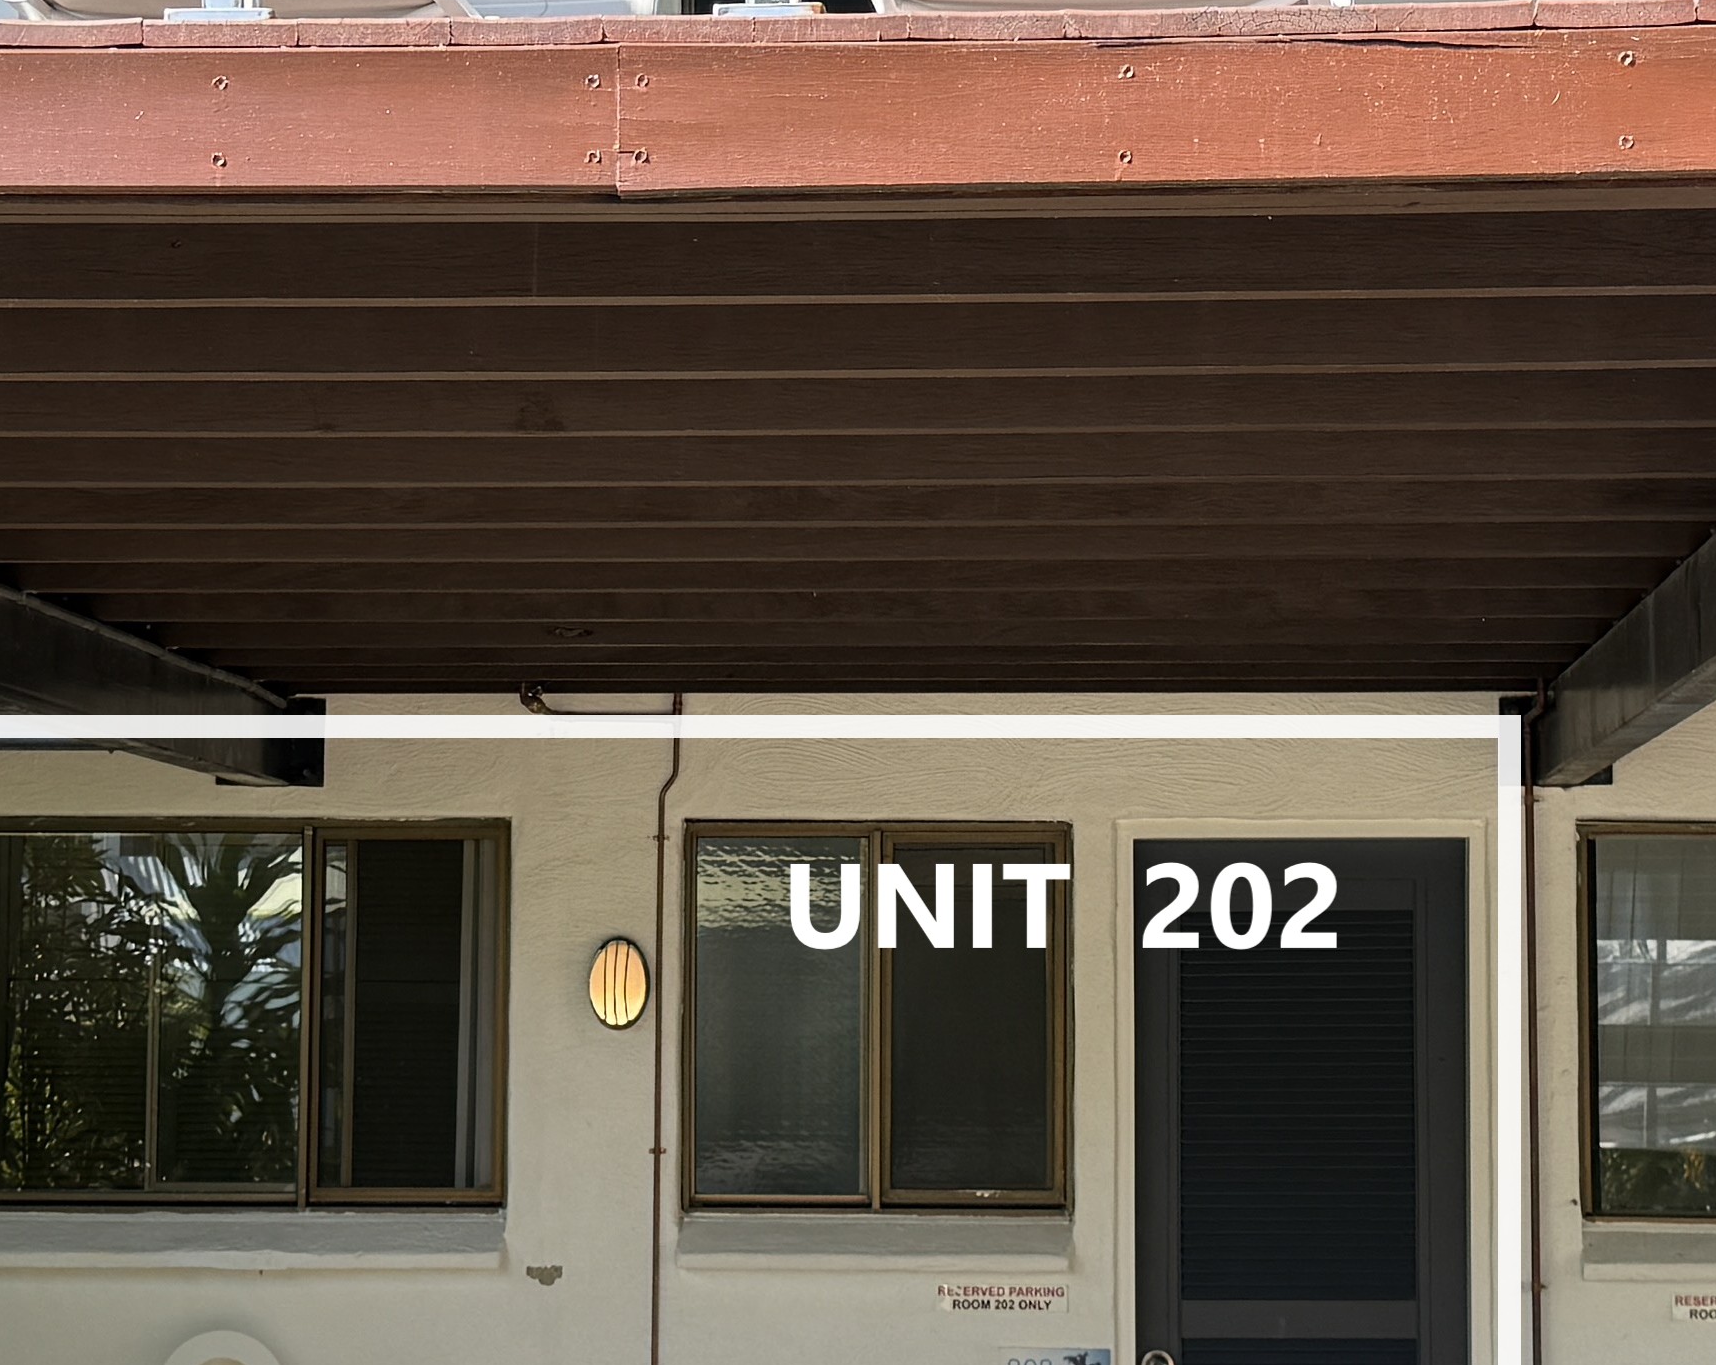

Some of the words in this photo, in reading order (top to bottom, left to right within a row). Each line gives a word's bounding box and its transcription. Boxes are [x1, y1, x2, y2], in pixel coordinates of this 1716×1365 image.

[1008, 1286, 1065, 1298] PARKING
[952, 1299, 991, 1310] ROOM
[994, 1299, 1015, 1310] 202
[1018, 1299, 1052, 1310] ONLY
